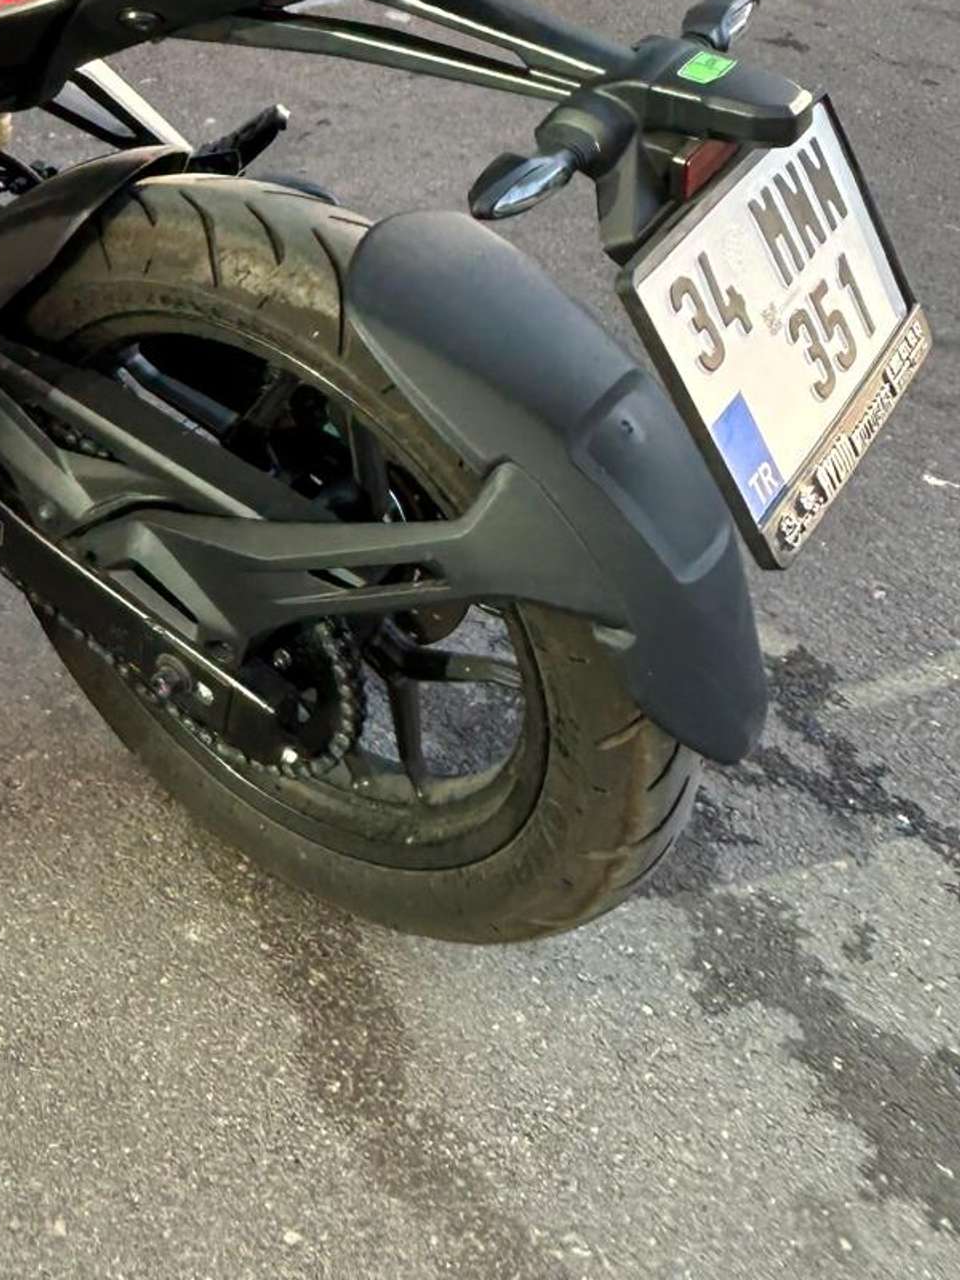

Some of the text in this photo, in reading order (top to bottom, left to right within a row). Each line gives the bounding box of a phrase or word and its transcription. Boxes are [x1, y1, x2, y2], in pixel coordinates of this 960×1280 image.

[669, 250, 753, 375] 34
[786, 252, 876, 403] 351
[747, 461, 784, 505] TR
